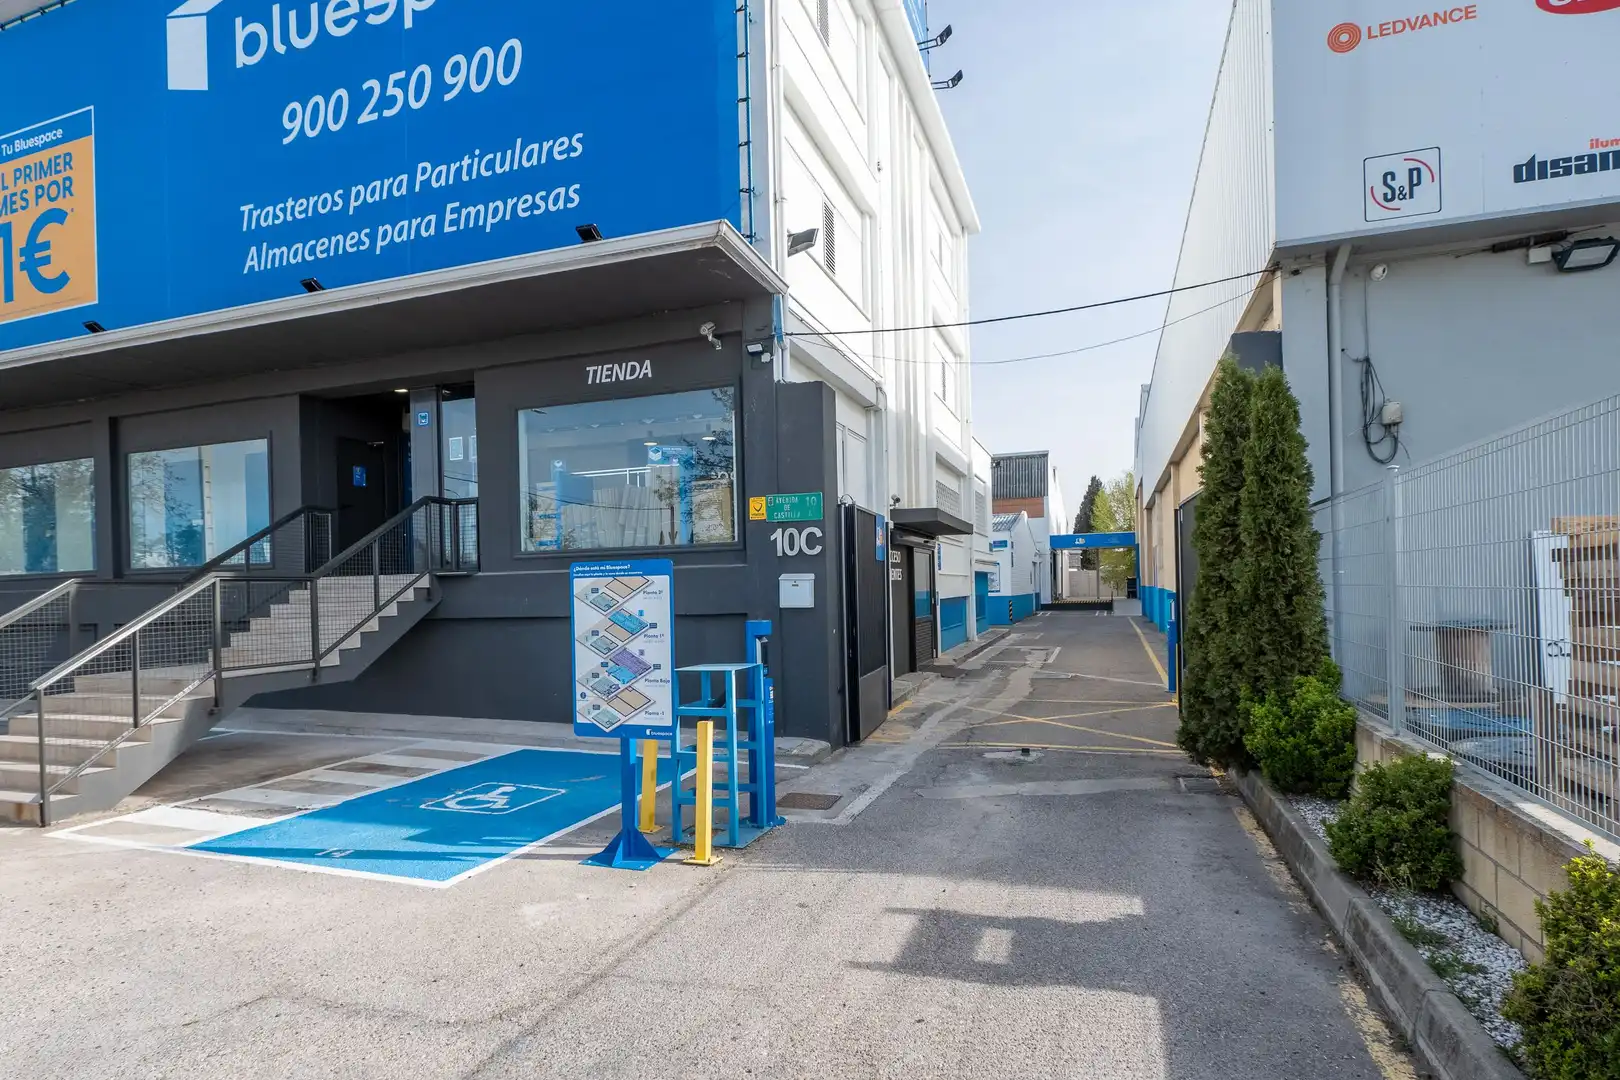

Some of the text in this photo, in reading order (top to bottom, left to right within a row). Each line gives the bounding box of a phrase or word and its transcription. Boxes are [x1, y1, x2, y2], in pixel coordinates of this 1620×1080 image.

[1367, 5, 1477, 40] LEDVANCE
[282, 38, 523, 145] 900 250 900
[1, 128, 63, 156] Tu Bluespace
[13, 151, 73, 188] PRIMER
[240, 132, 584, 232] Trasteros para Particulares
[1382, 167, 1422, 203] S&P
[35, 175, 74, 207] POR
[243, 183, 580, 274] Almacenes para Empresas
[586, 359, 652, 385] TIENDA
[770, 526, 823, 557] 10C
